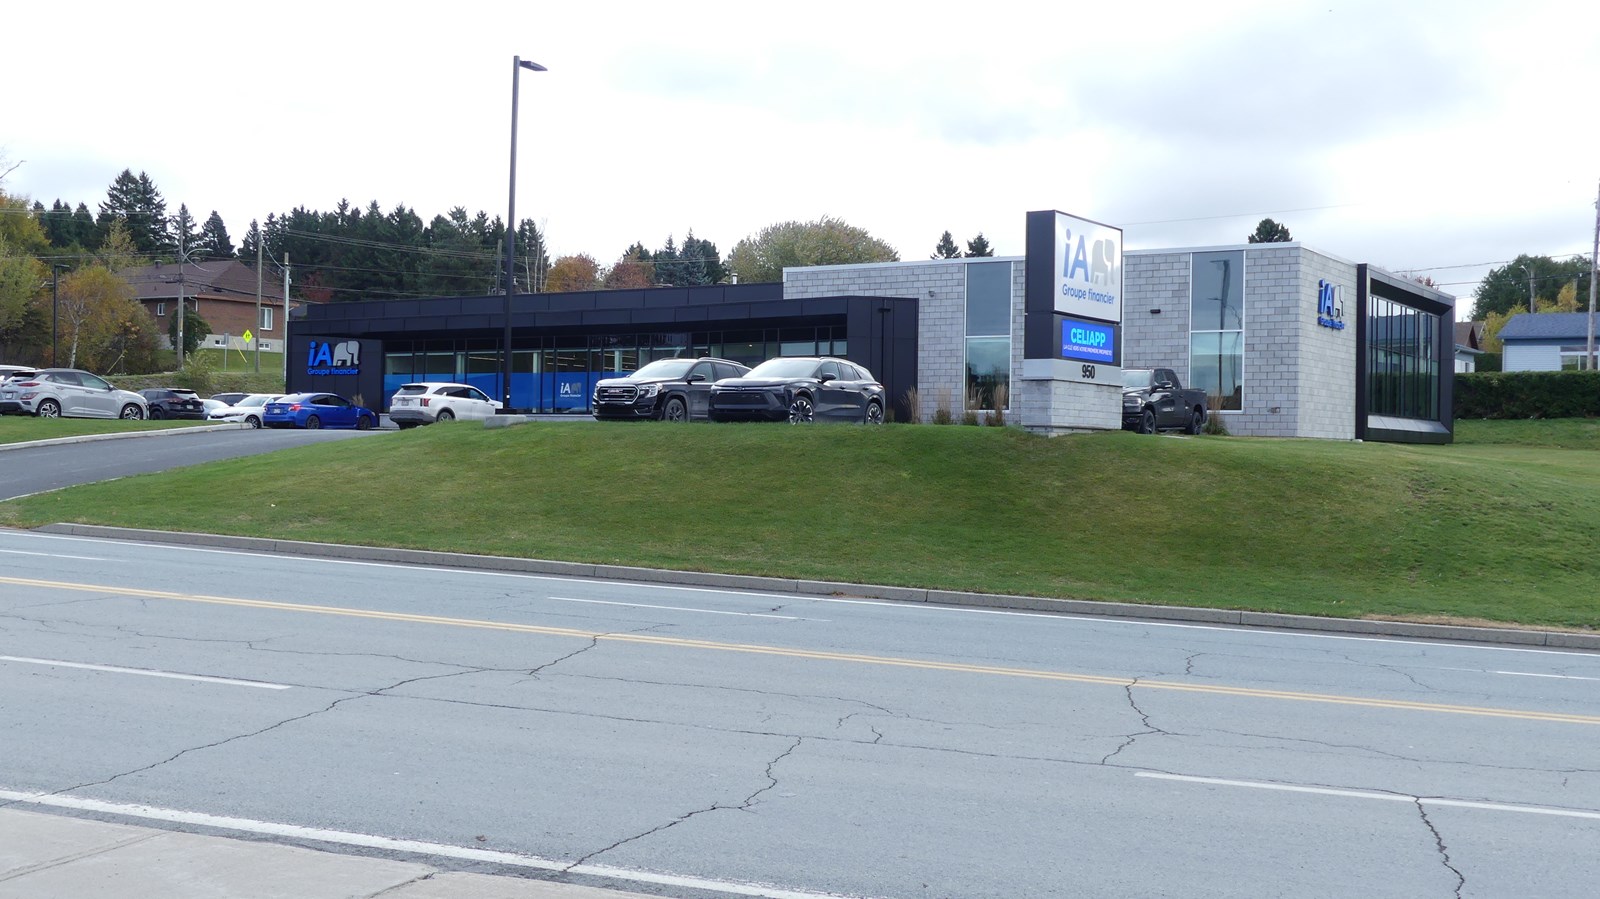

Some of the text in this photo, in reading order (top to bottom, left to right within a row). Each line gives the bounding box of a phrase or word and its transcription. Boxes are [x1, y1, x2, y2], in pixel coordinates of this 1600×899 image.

[1063, 228, 1089, 282] iA
[1062, 284, 1115, 304] Groupe financier
[1317, 278, 1333, 317] iA
[1071, 328, 1106, 347] CELIAPP
[308, 341, 332, 366] iA
[308, 368, 330, 376] Groupe
[1082, 364, 1096, 379] 950
[560, 382, 571, 394] iA
